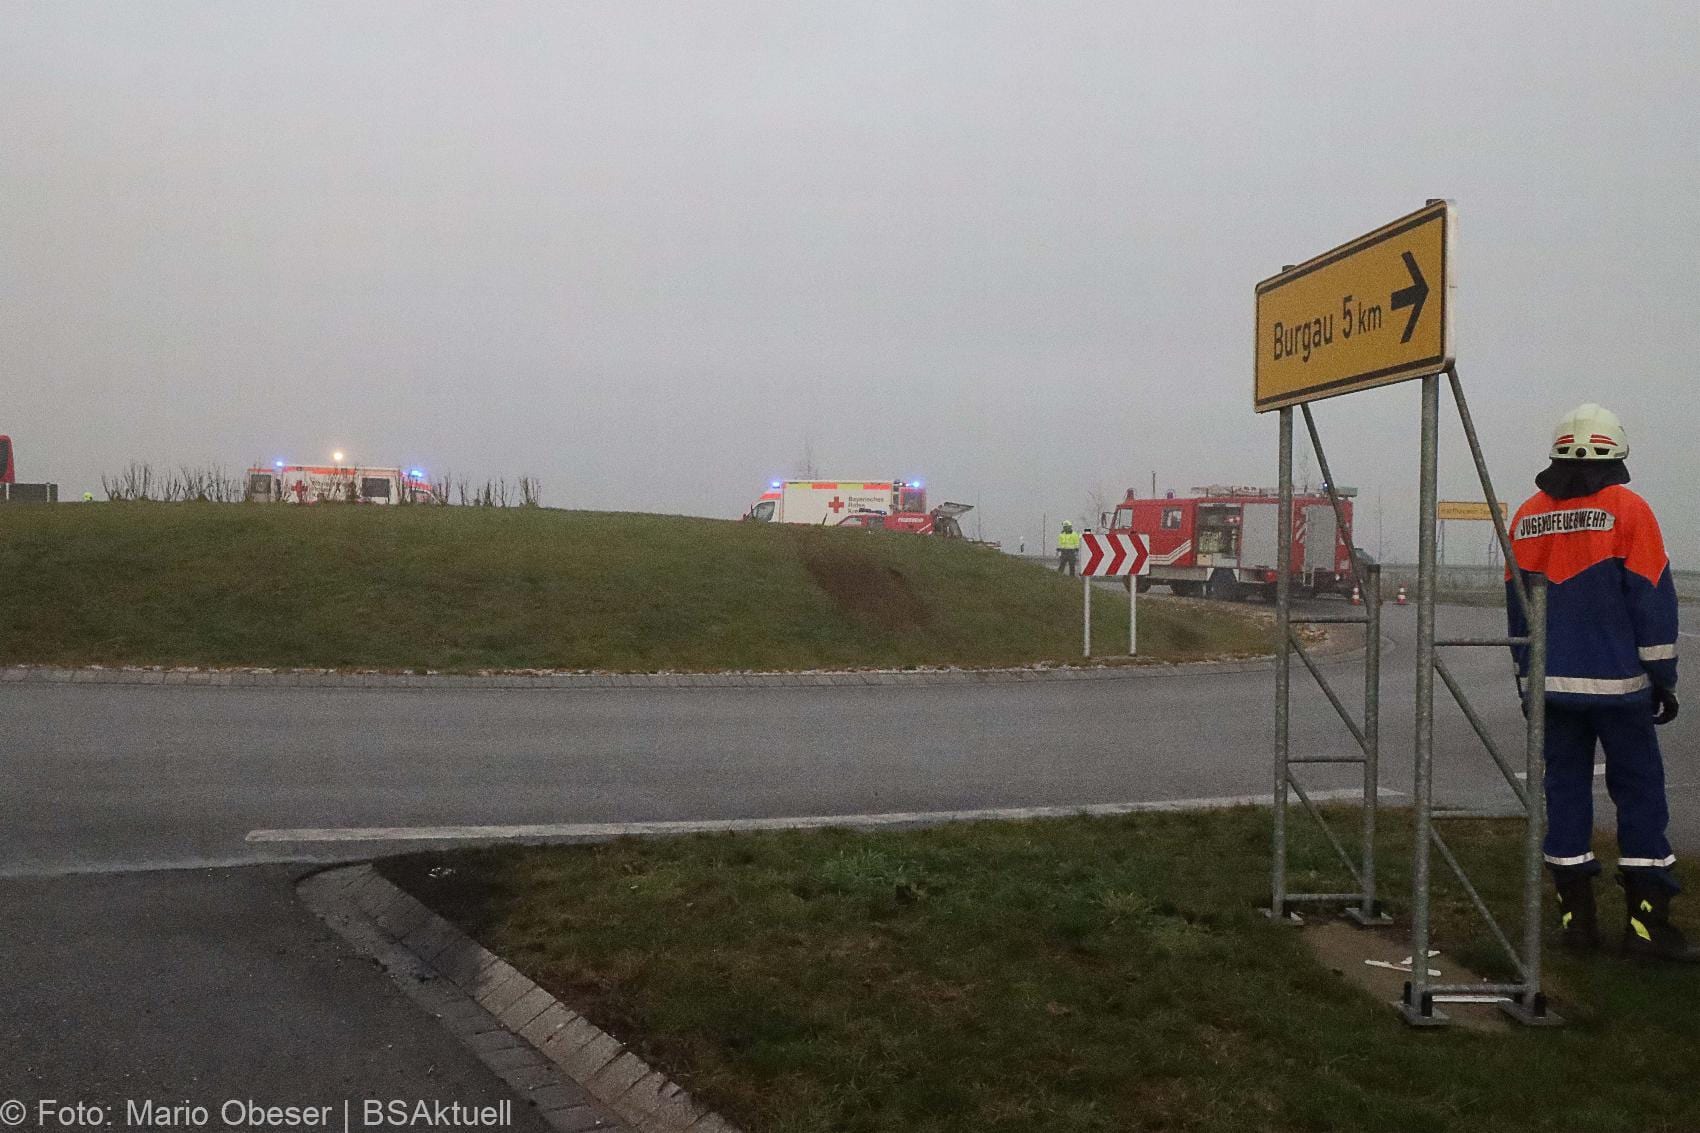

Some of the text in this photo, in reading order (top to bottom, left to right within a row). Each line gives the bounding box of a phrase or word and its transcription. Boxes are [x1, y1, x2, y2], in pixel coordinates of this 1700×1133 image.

[1273, 295, 1382, 363] Burgau 5 km
[1520, 510, 1607, 536] JUGENDFEUERWEHR
